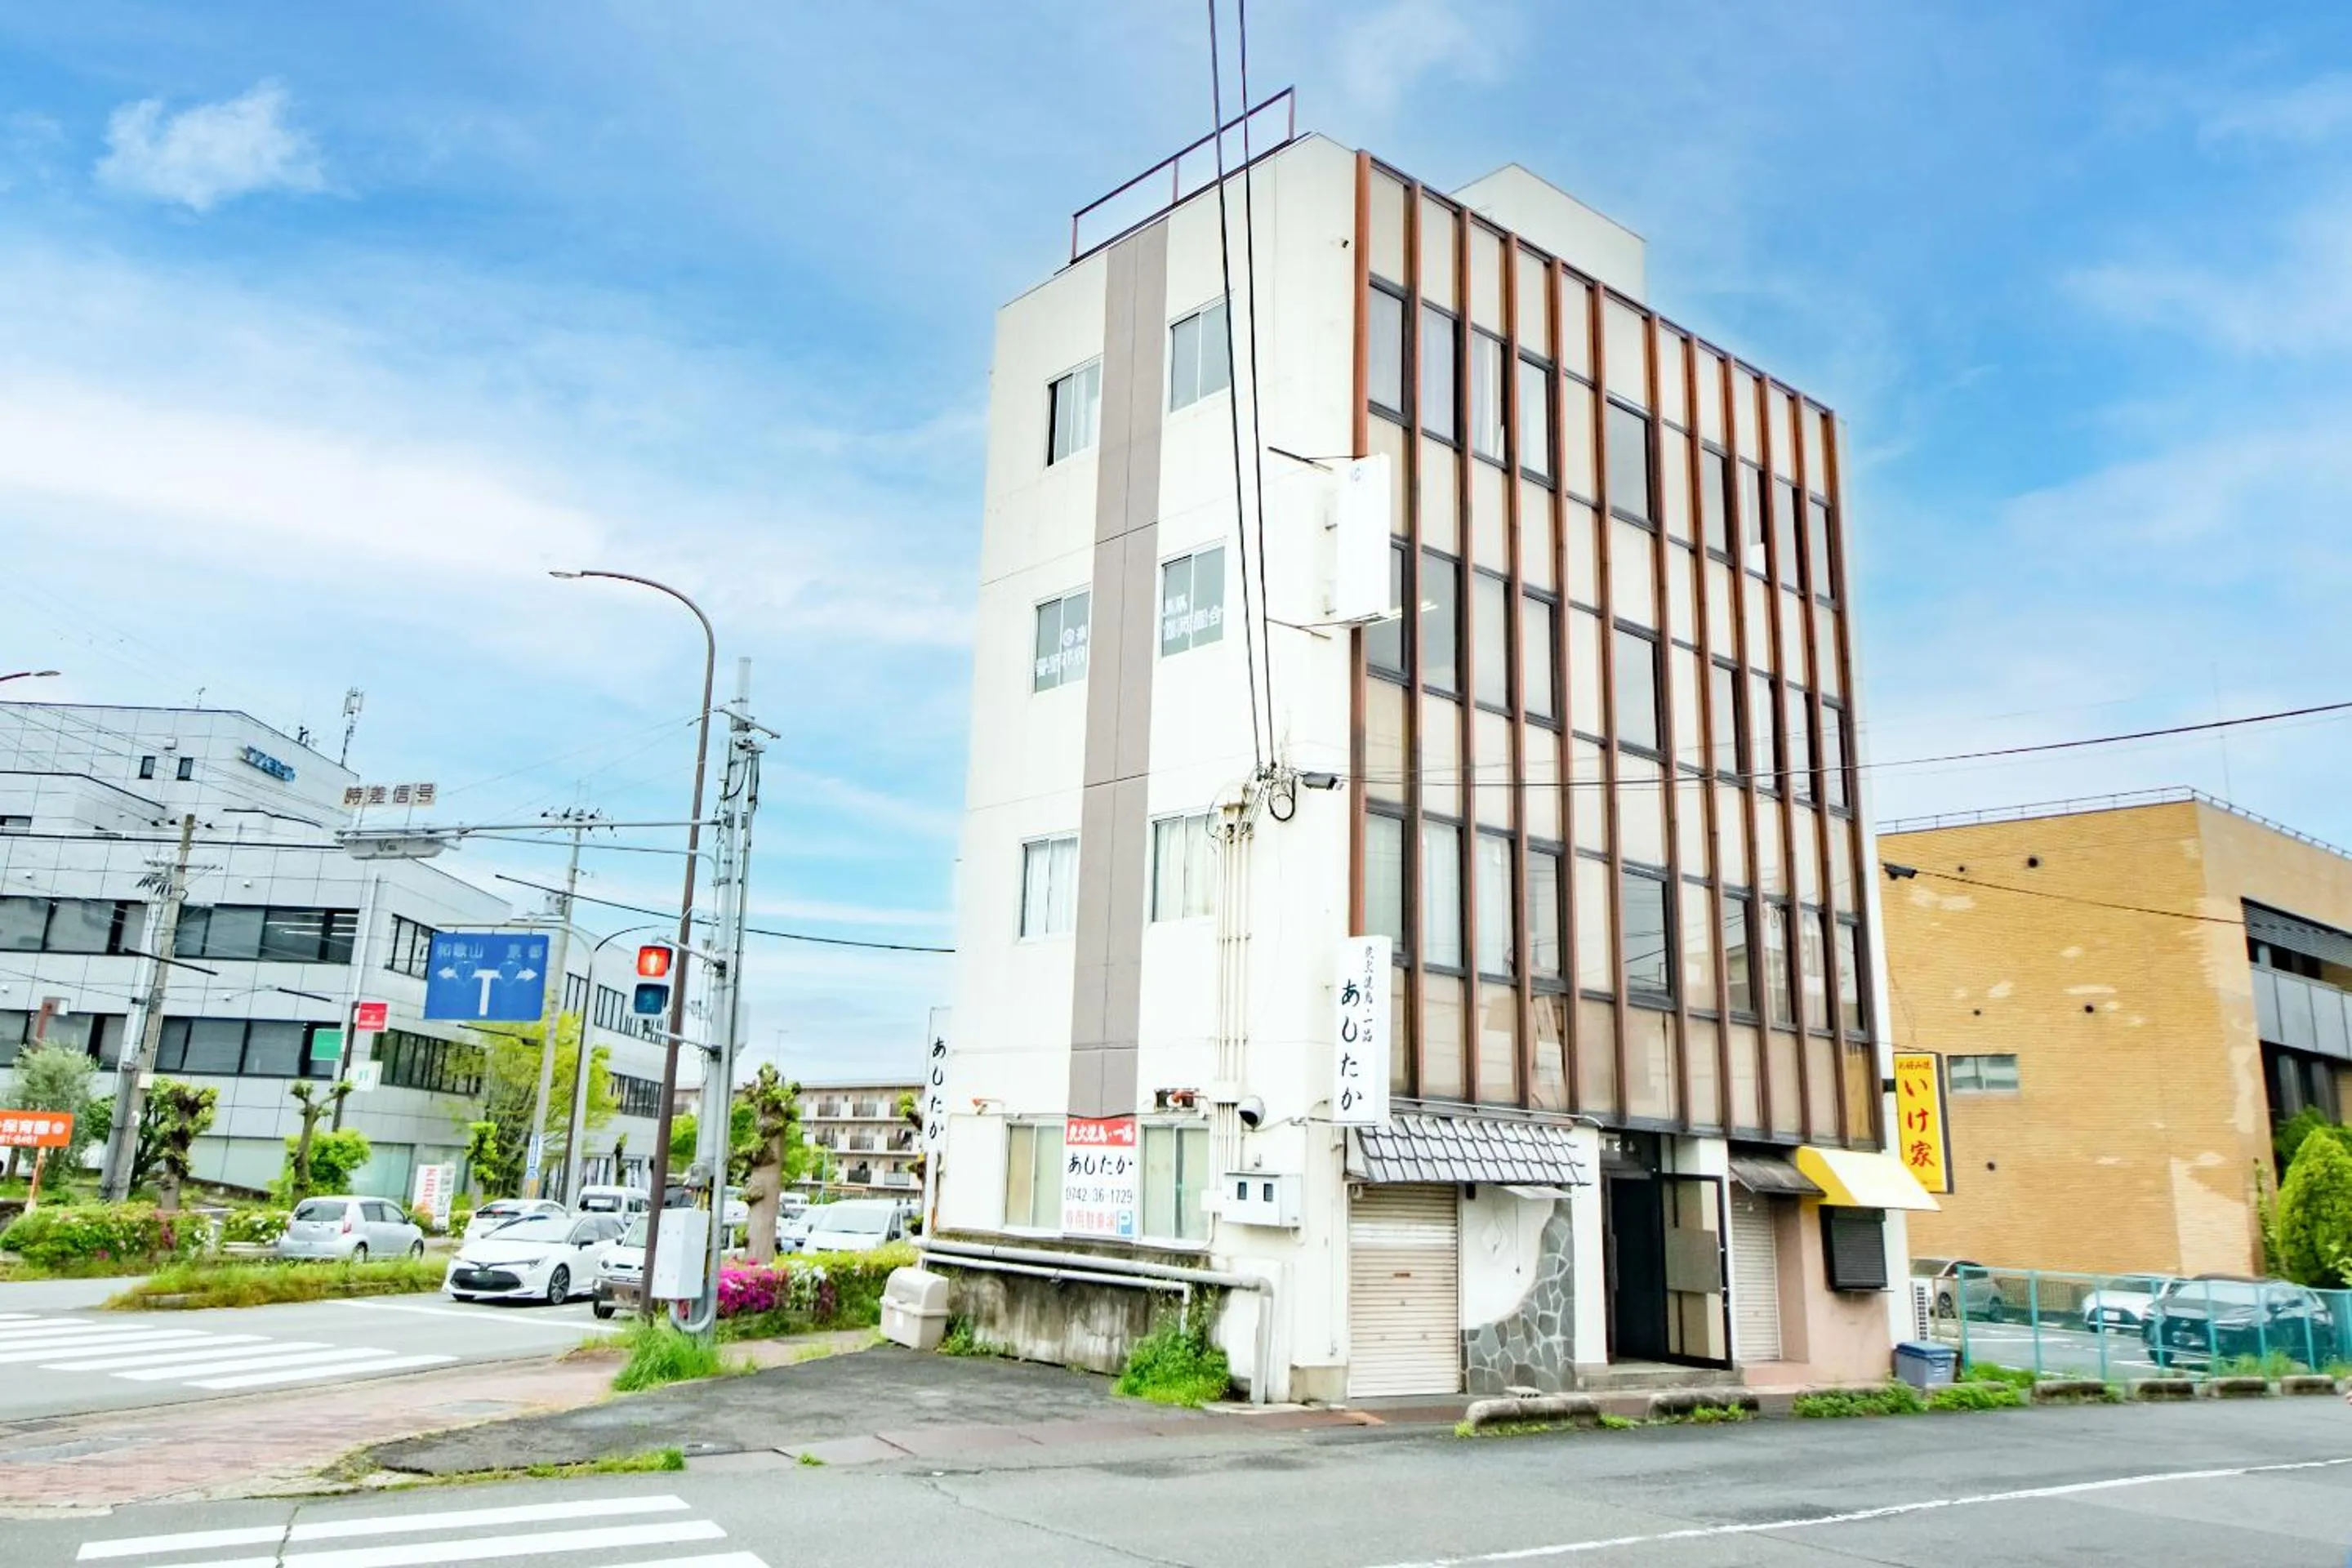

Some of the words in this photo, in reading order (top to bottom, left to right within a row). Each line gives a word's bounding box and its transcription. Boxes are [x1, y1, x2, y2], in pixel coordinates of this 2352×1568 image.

[344, 784, 434, 805] 時差信号
[437, 942, 484, 959] 和歌山
[1341, 978, 1363, 1111] あしたか
[929, 1036, 946, 1140] あしたか
[0, 1119, 51, 1135] 保育園
[1904, 1078, 1936, 1168] いけ家
[1067, 1152, 1133, 1175] あしたか
